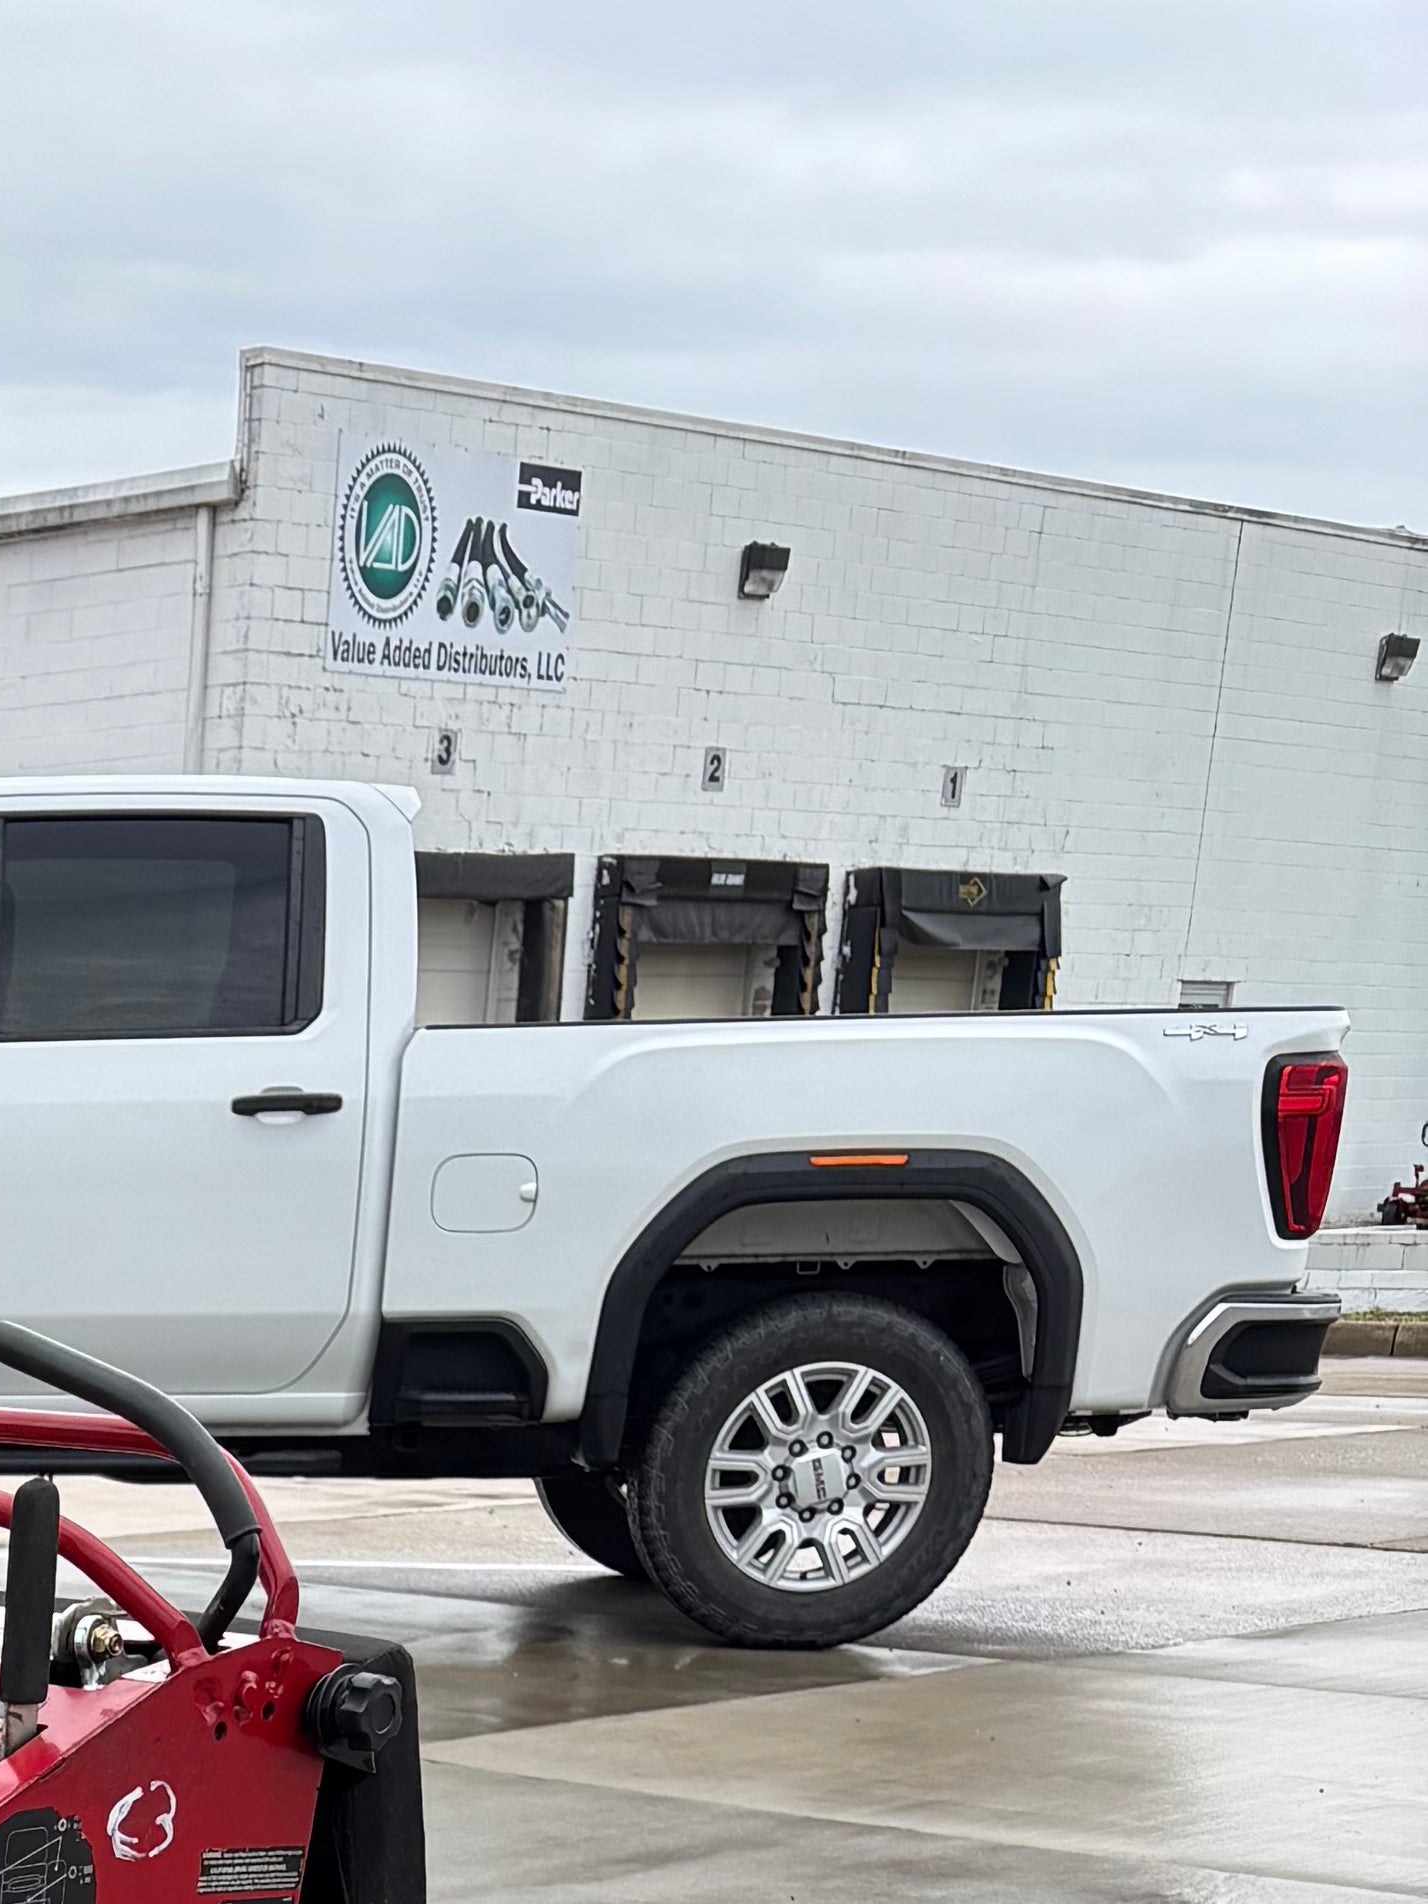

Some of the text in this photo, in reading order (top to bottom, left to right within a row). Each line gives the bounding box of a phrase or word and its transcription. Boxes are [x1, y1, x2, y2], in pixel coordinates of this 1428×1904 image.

[529, 476, 581, 511] Parker
[330, 630, 566, 684] Value Added Distributors, LLC
[437, 734, 453, 767] 3
[708, 753, 722, 783] 2
[948, 770, 959, 800] 1
